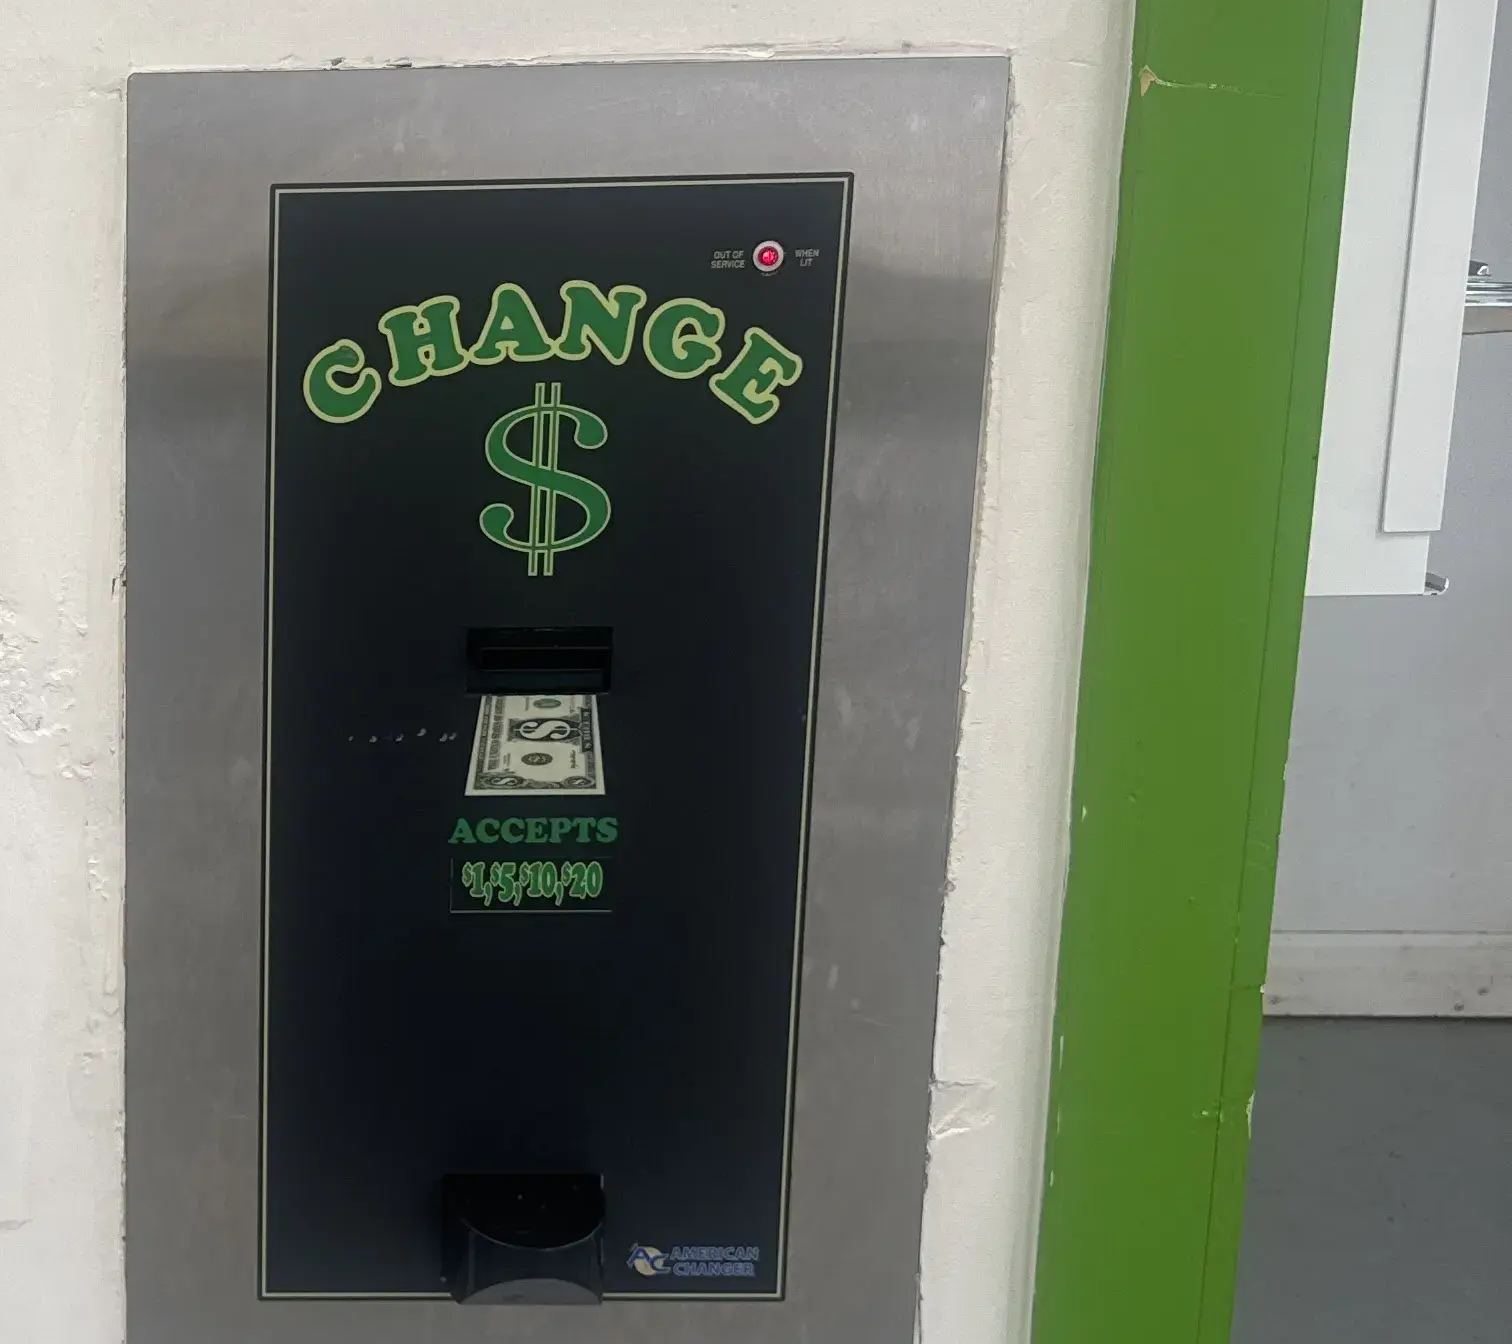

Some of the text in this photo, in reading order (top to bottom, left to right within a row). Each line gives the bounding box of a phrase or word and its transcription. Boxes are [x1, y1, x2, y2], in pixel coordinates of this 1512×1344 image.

[713, 250, 731, 259] OUT
[794, 249, 820, 258] WHEN
[710, 259, 746, 269] SERVICE
[799, 258, 814, 267] LIT
[303, 280, 803, 424] CHANGE
[479, 383, 611, 576] $
[448, 817, 619, 844] ACCEPTS
[669, 1246, 760, 1261] AMERICAN
[673, 1262, 756, 1276] CHANGER
